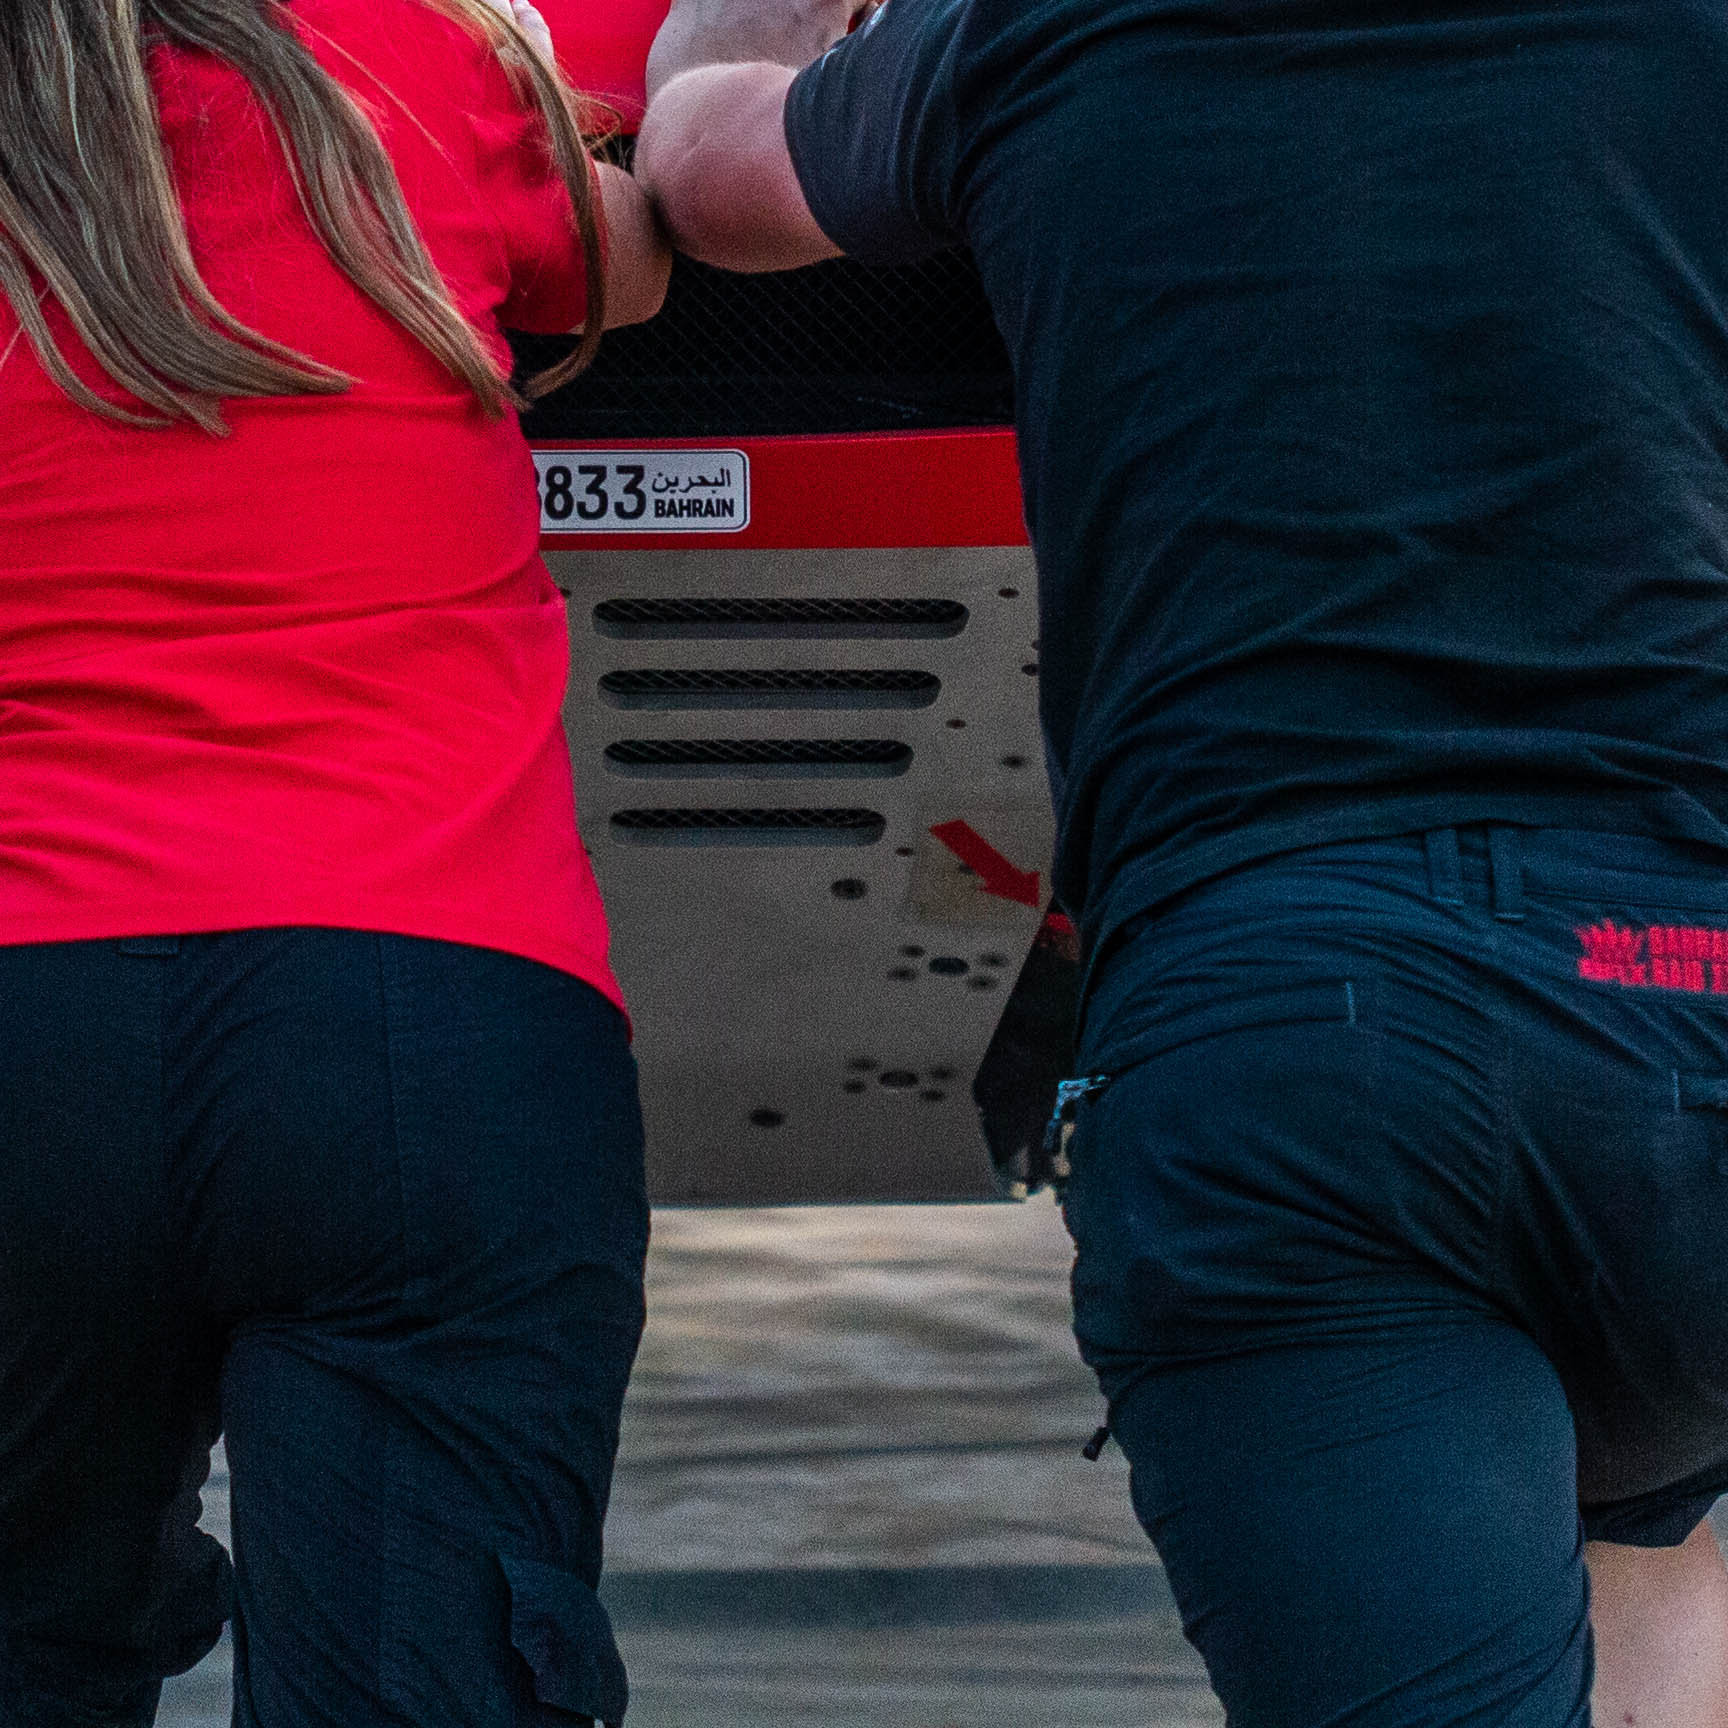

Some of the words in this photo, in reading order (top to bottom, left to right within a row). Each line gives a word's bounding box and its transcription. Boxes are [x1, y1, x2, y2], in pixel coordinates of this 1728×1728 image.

[536, 465, 647, 520] 833
[651, 468, 731, 494] البحرين
[654, 498, 735, 519] BAHRAIN
